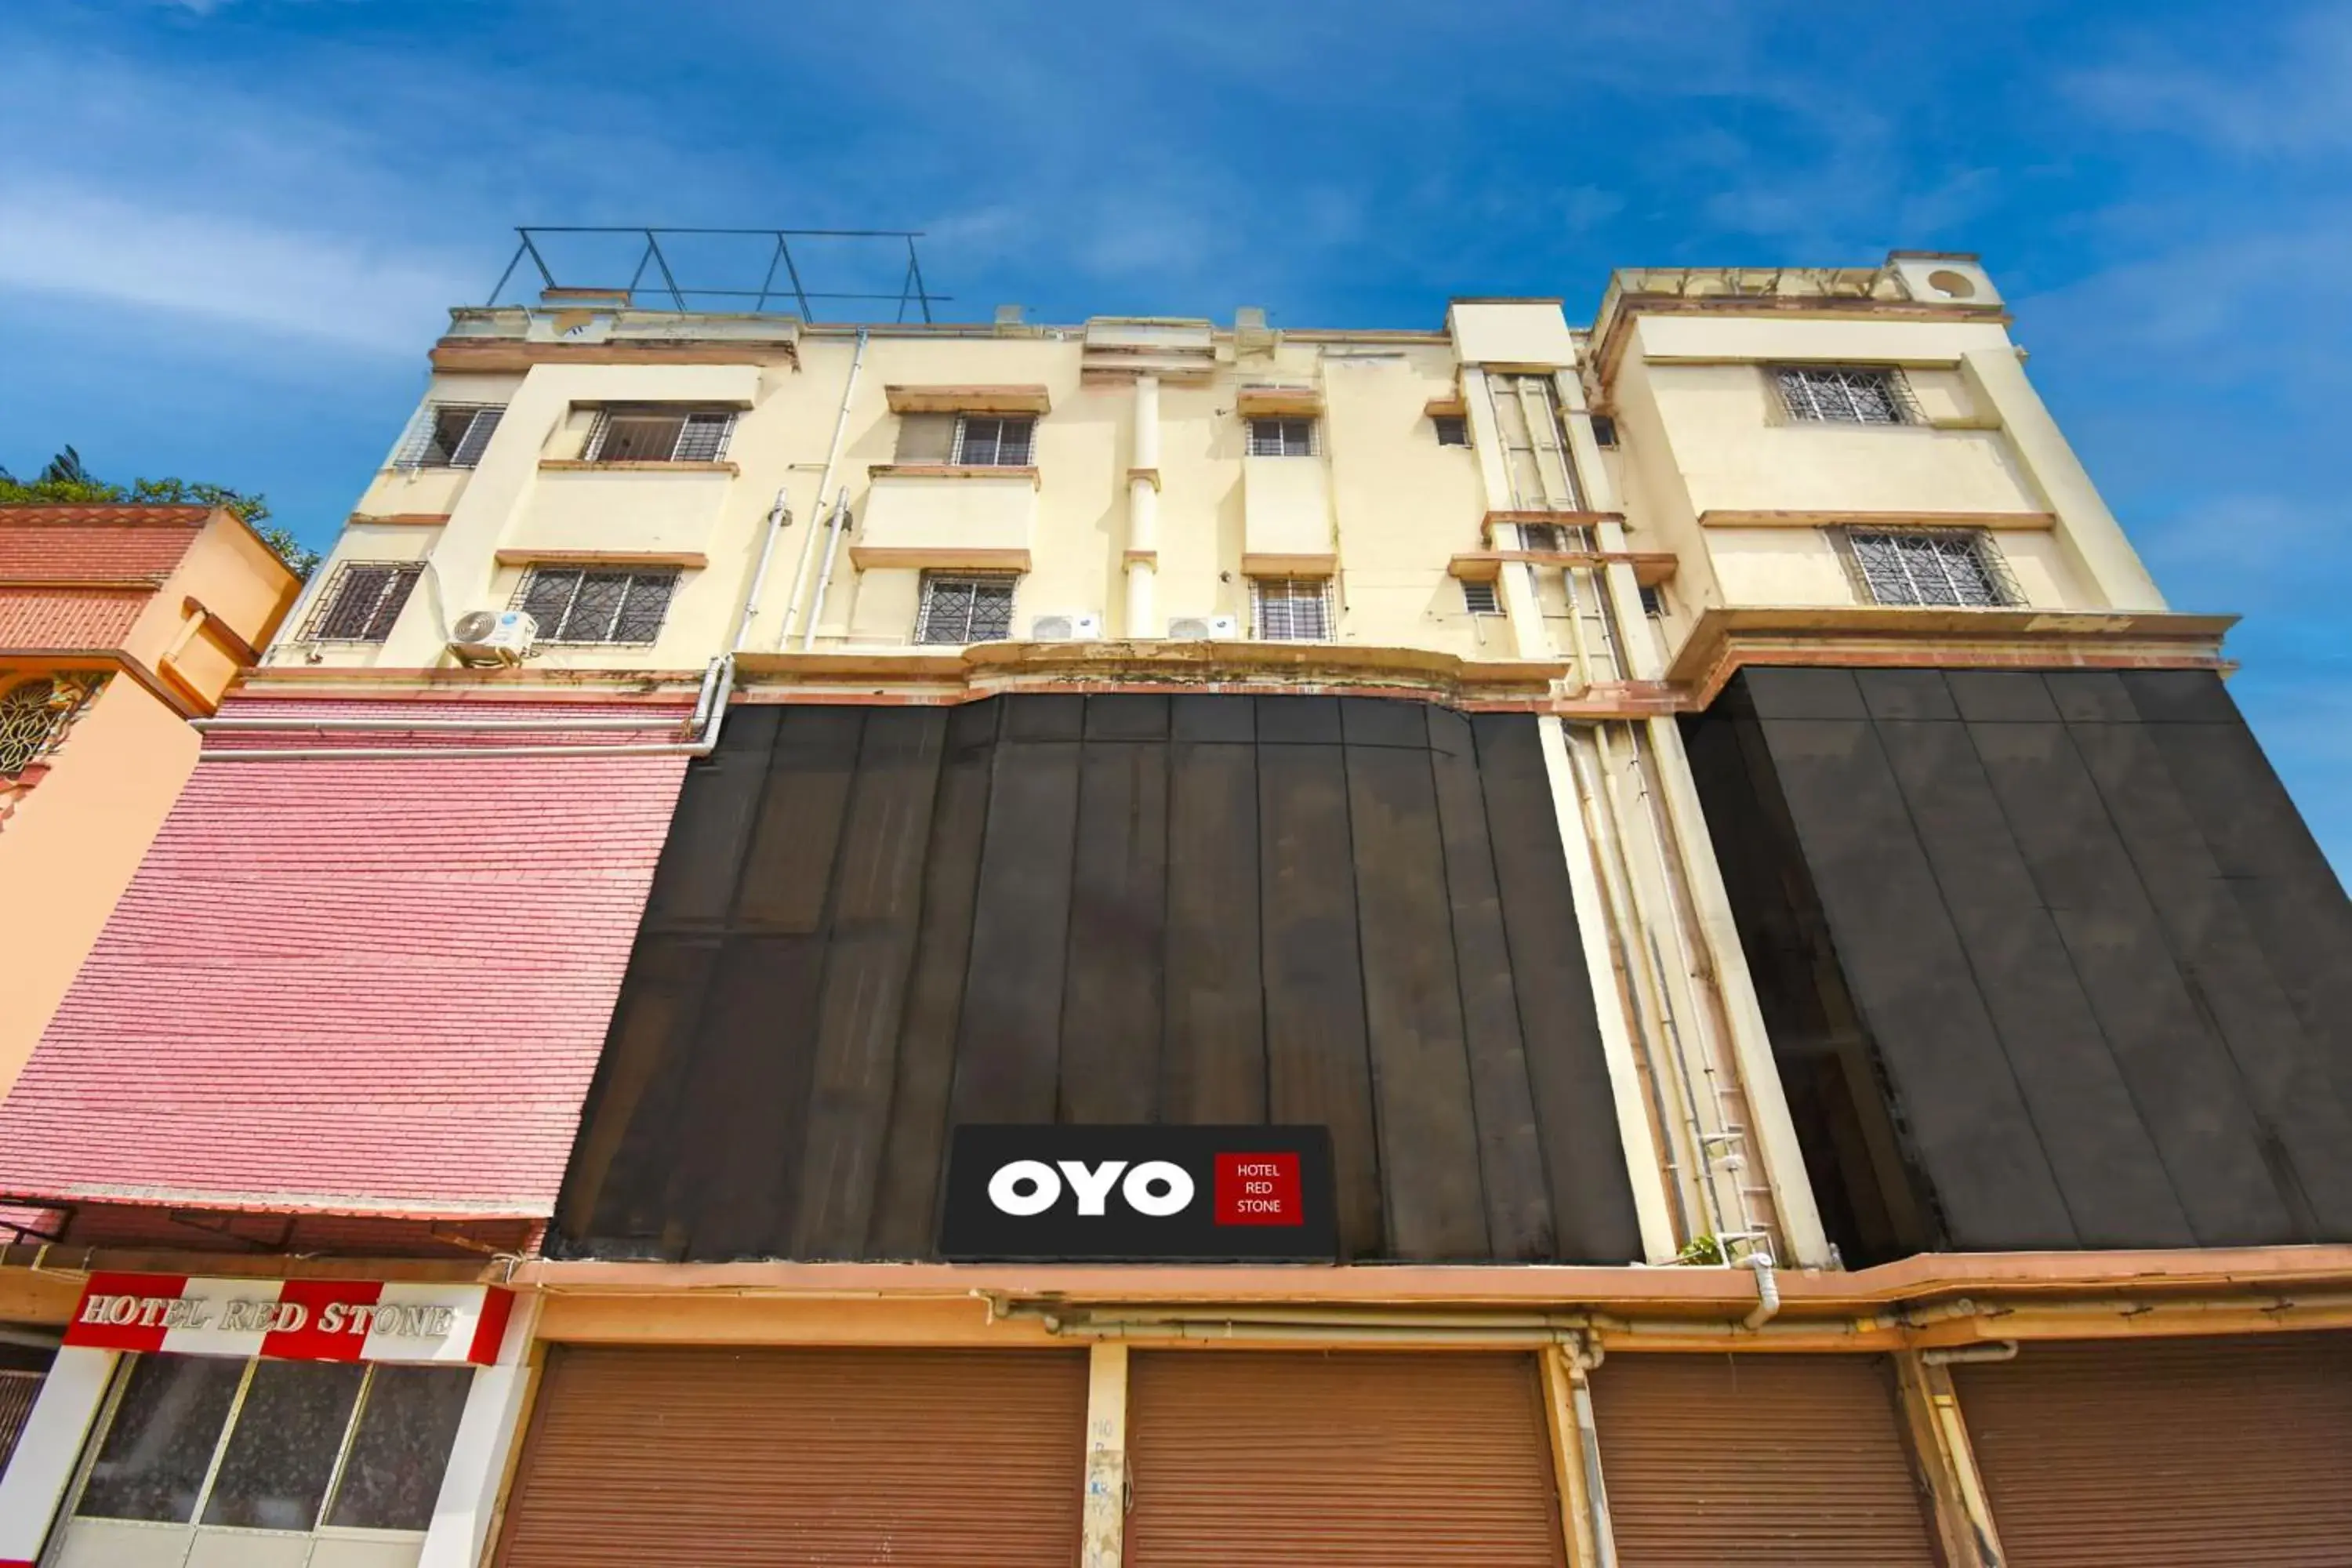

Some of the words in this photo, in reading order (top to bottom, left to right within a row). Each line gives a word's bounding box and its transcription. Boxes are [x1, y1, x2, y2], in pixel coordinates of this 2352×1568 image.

[1237, 1164, 1280, 1177] HOTEL
[988, 1160, 1195, 1216] OYO
[1245, 1182, 1272, 1195] RED
[1237, 1200, 1281, 1213] STONE
[80, 1294, 211, 1330] HOTEL
[218, 1301, 308, 1333] RED
[318, 1303, 456, 1337] STONE
